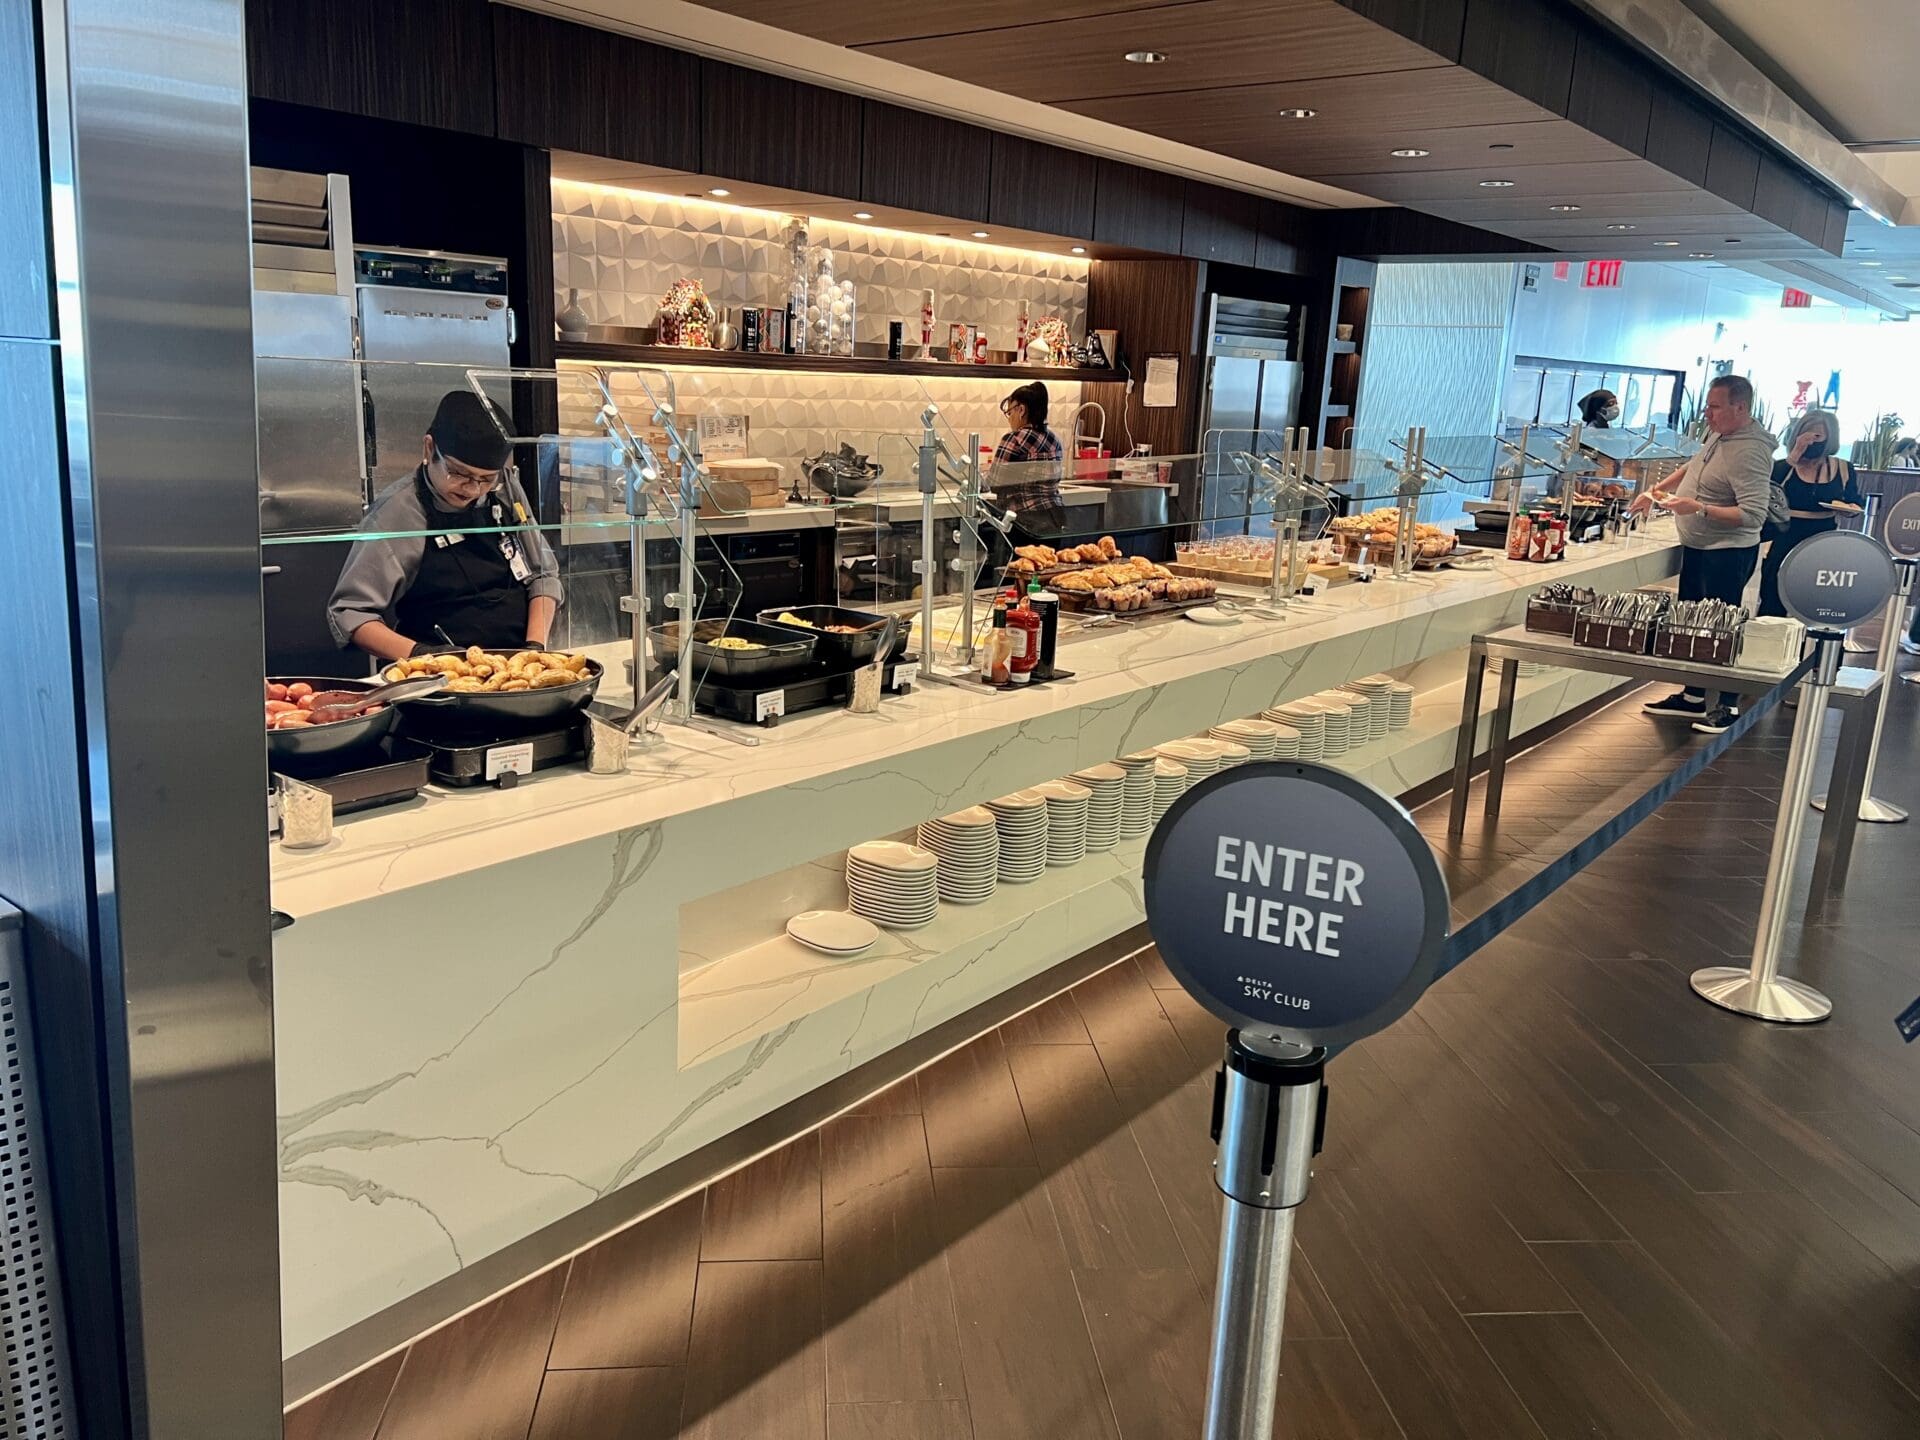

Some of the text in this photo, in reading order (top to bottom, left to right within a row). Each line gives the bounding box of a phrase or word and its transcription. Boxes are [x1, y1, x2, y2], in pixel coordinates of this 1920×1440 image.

[1586, 260, 1622, 287] EXIT
[1816, 570, 1858, 588] EXIT
[1214, 835, 1365, 906] ENTER
[1223, 892, 1345, 958] HERE
[1245, 977, 1272, 988] DELTA
[1244, 985, 1311, 1011] SKY CLUB
